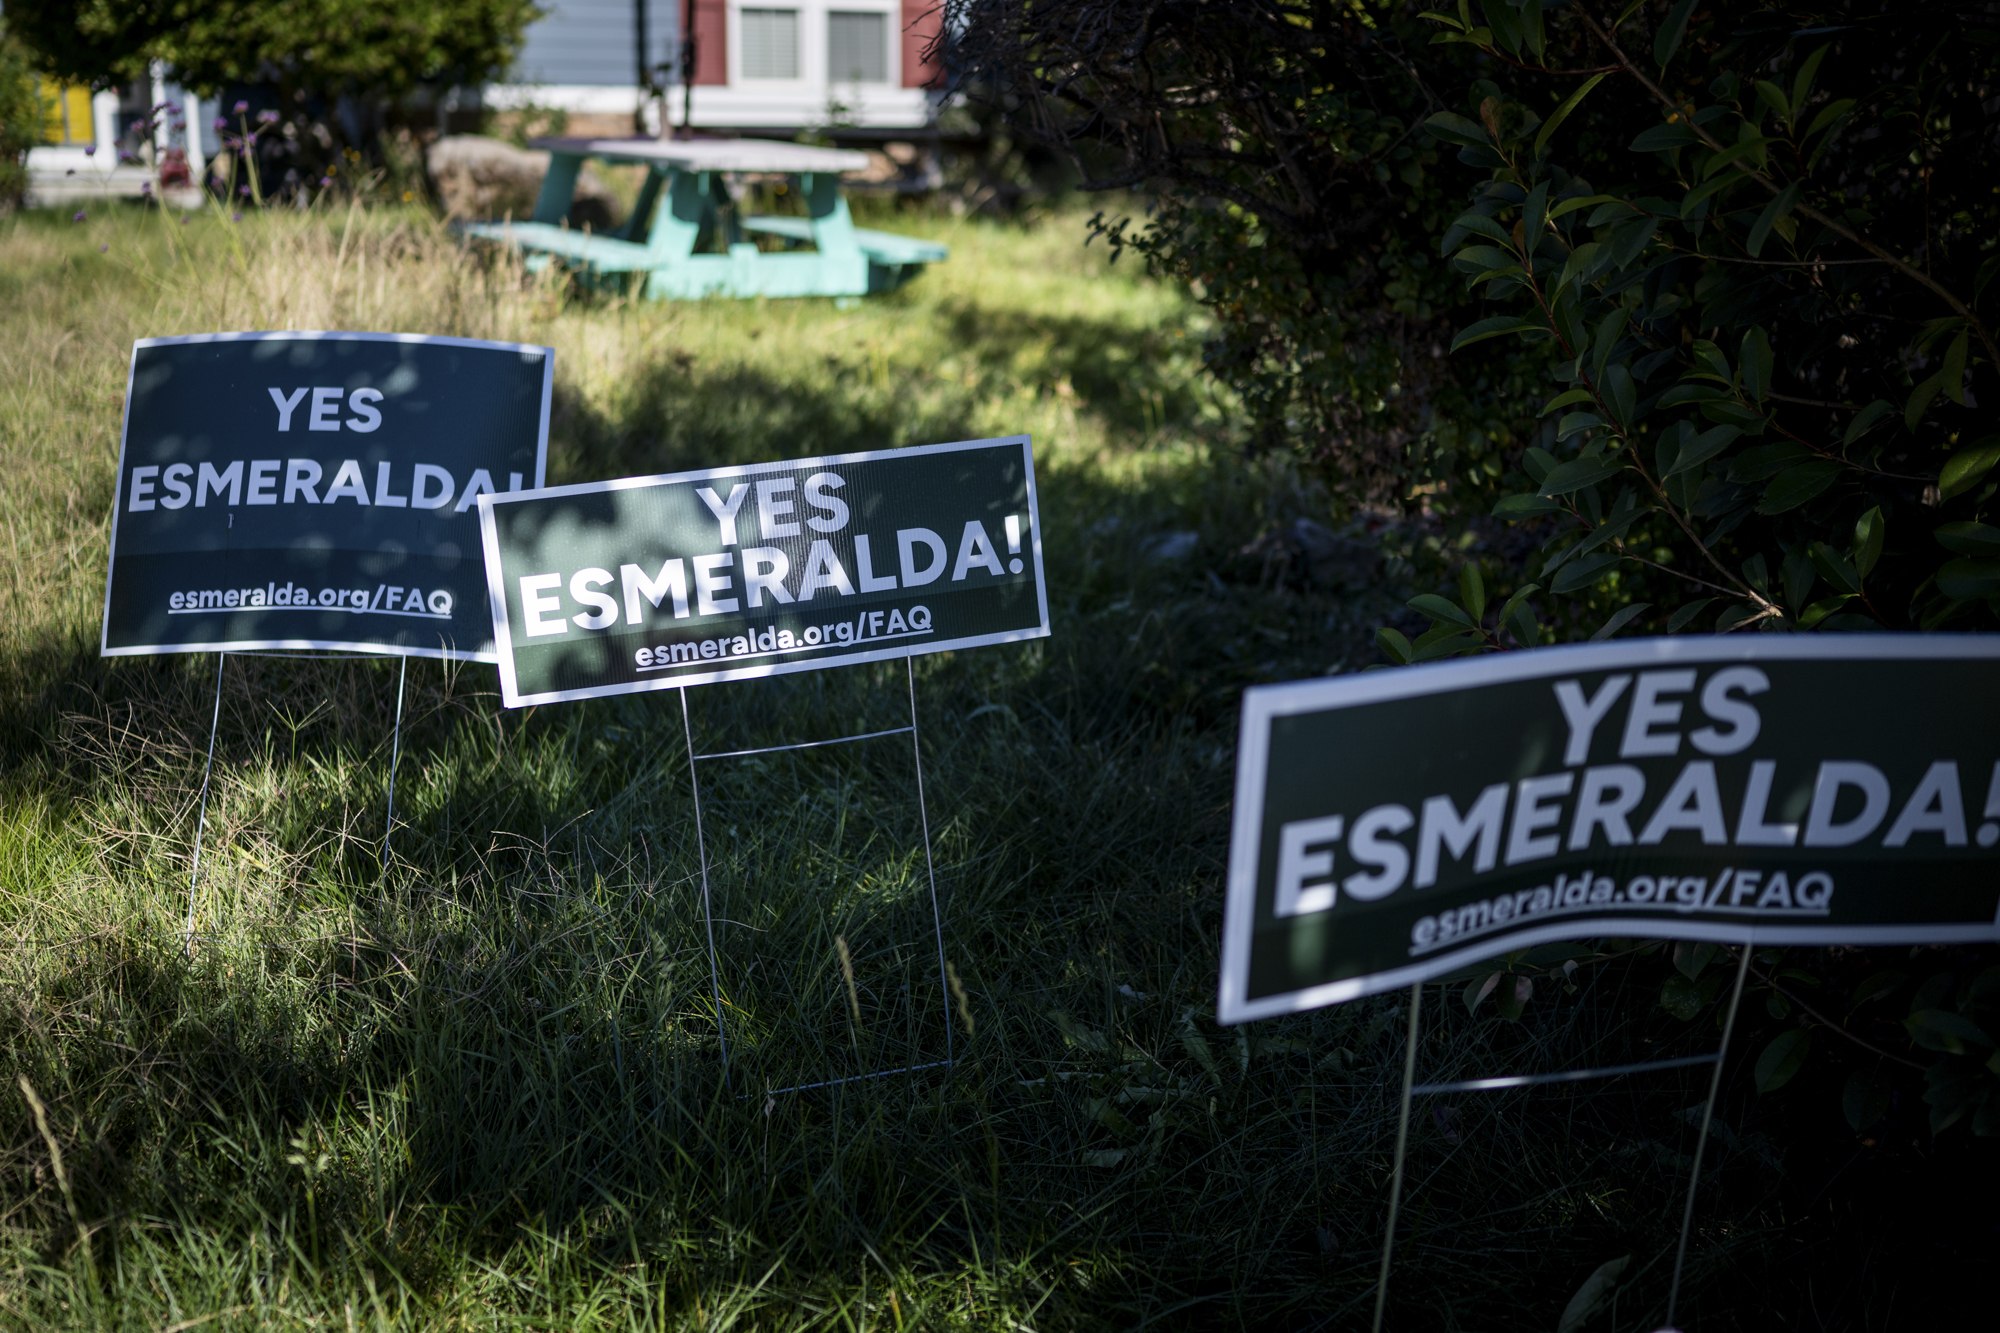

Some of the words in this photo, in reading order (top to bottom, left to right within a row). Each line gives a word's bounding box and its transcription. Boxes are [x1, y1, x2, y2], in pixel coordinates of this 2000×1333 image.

[268, 387, 384, 433] YES
[697, 472, 850, 546] YES
[168, 582, 453, 614] esmeralda.org/FAQ
[519, 514, 1025, 638] ESMERALDA!
[635, 605, 934, 668] esmeralda.org/FAQ
[1553, 666, 1770, 766] YES
[1409, 868, 1834, 952] esmeralda.org/FAQ
